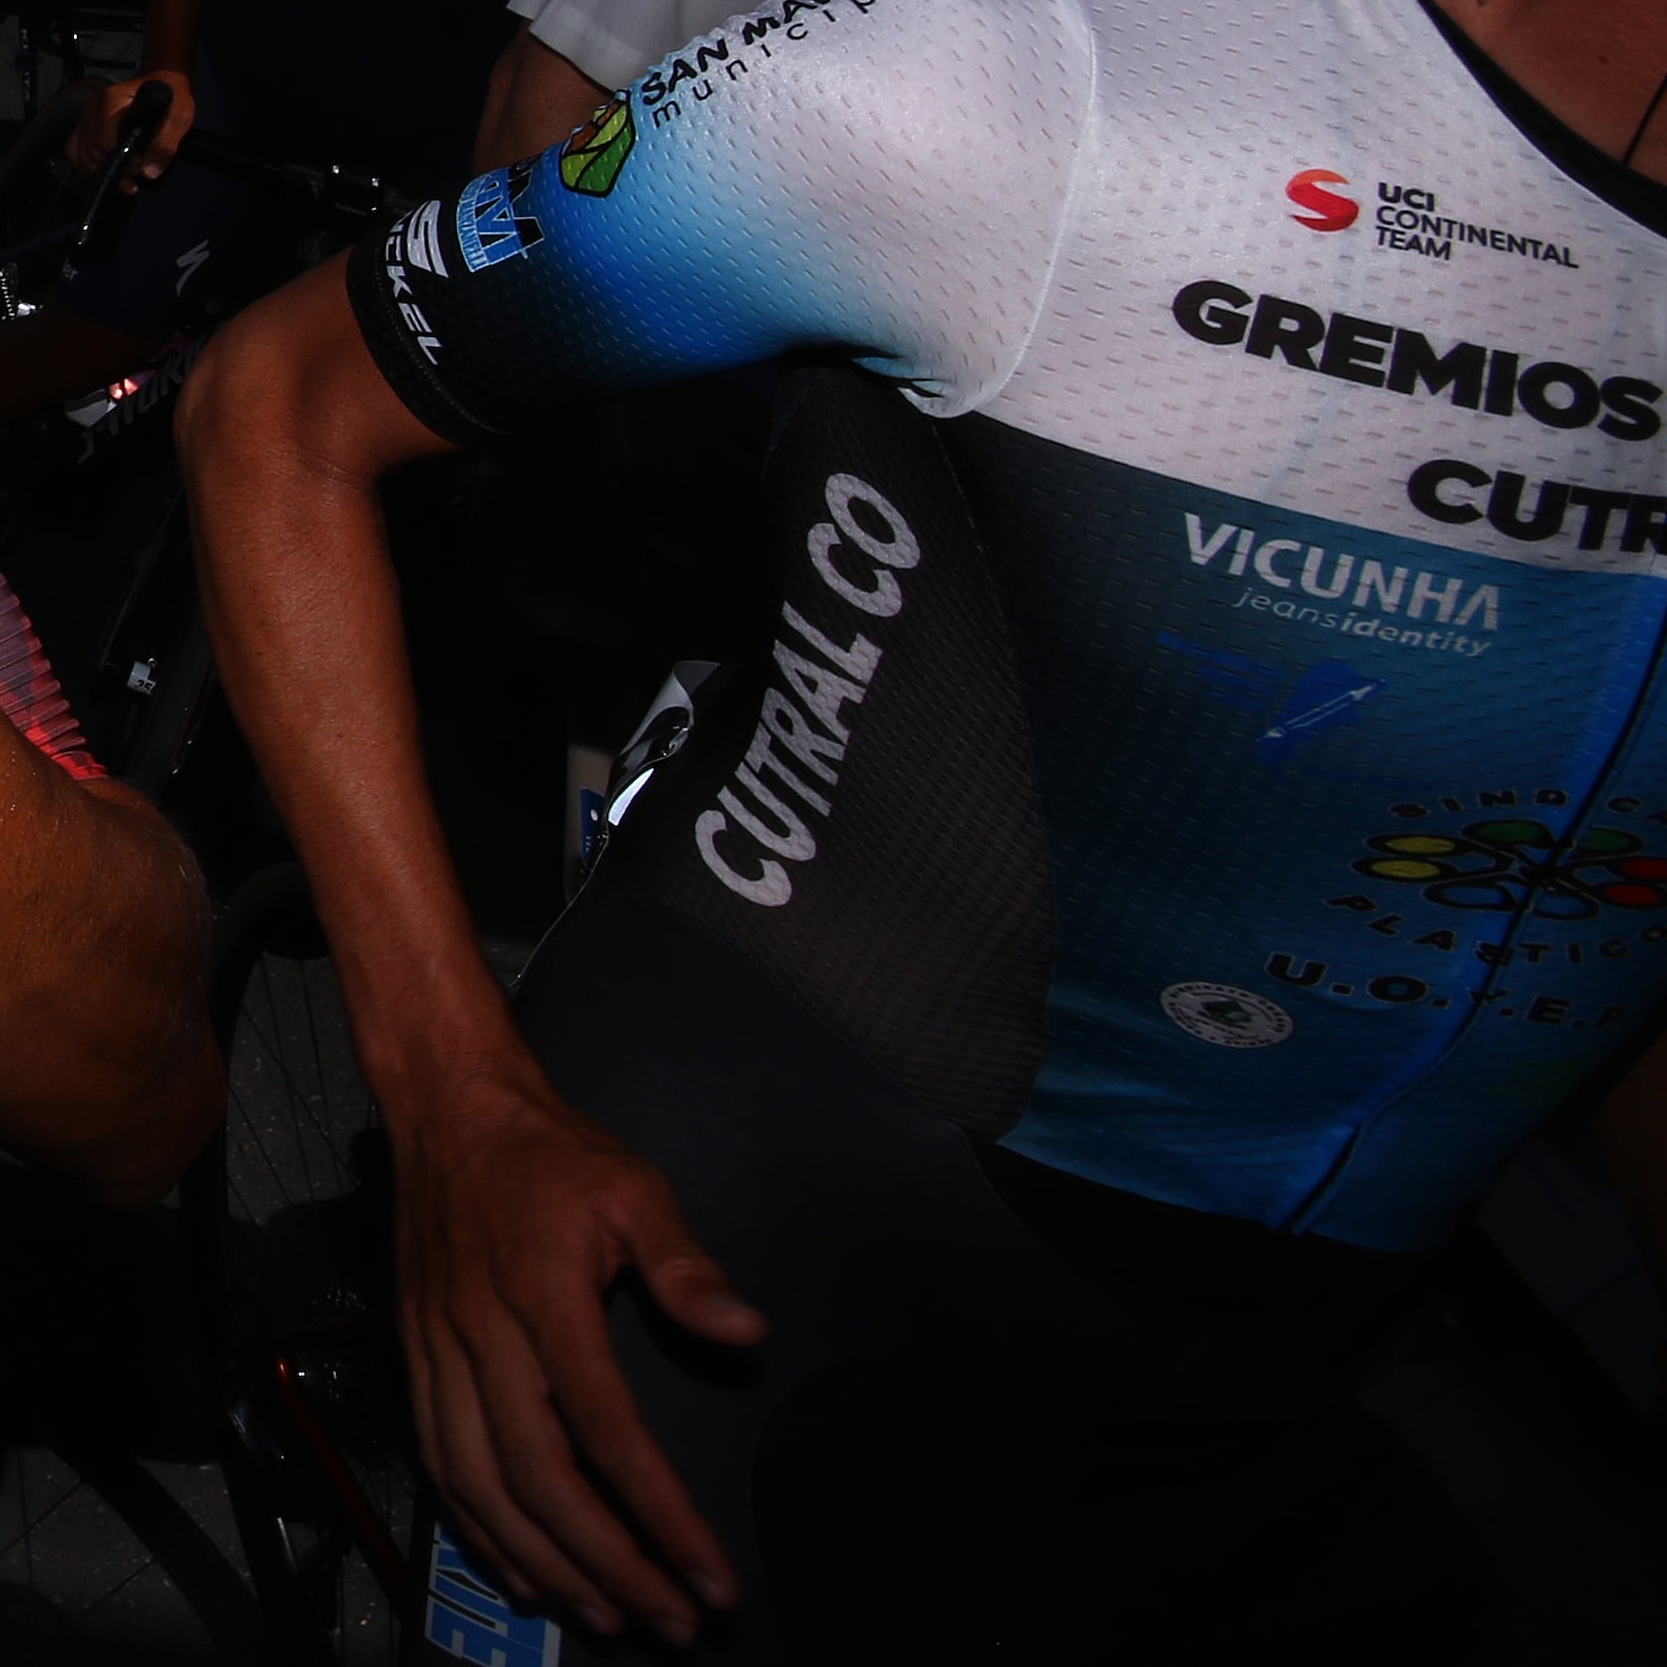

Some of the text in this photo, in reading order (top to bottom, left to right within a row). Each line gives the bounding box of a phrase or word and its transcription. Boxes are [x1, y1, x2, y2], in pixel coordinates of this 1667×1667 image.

[642, 38, 728, 105] SAN
[1378, 182, 1435, 212] UCI
[1376, 206, 1579, 269] CONTINENTAL
[1376, 225, 1451, 262] TEAM
[1172, 280, 1664, 442] GREMIOS
[1184, 511, 1500, 631] VICUNHA
[694, 471, 922, 908] CUTRAL CO
